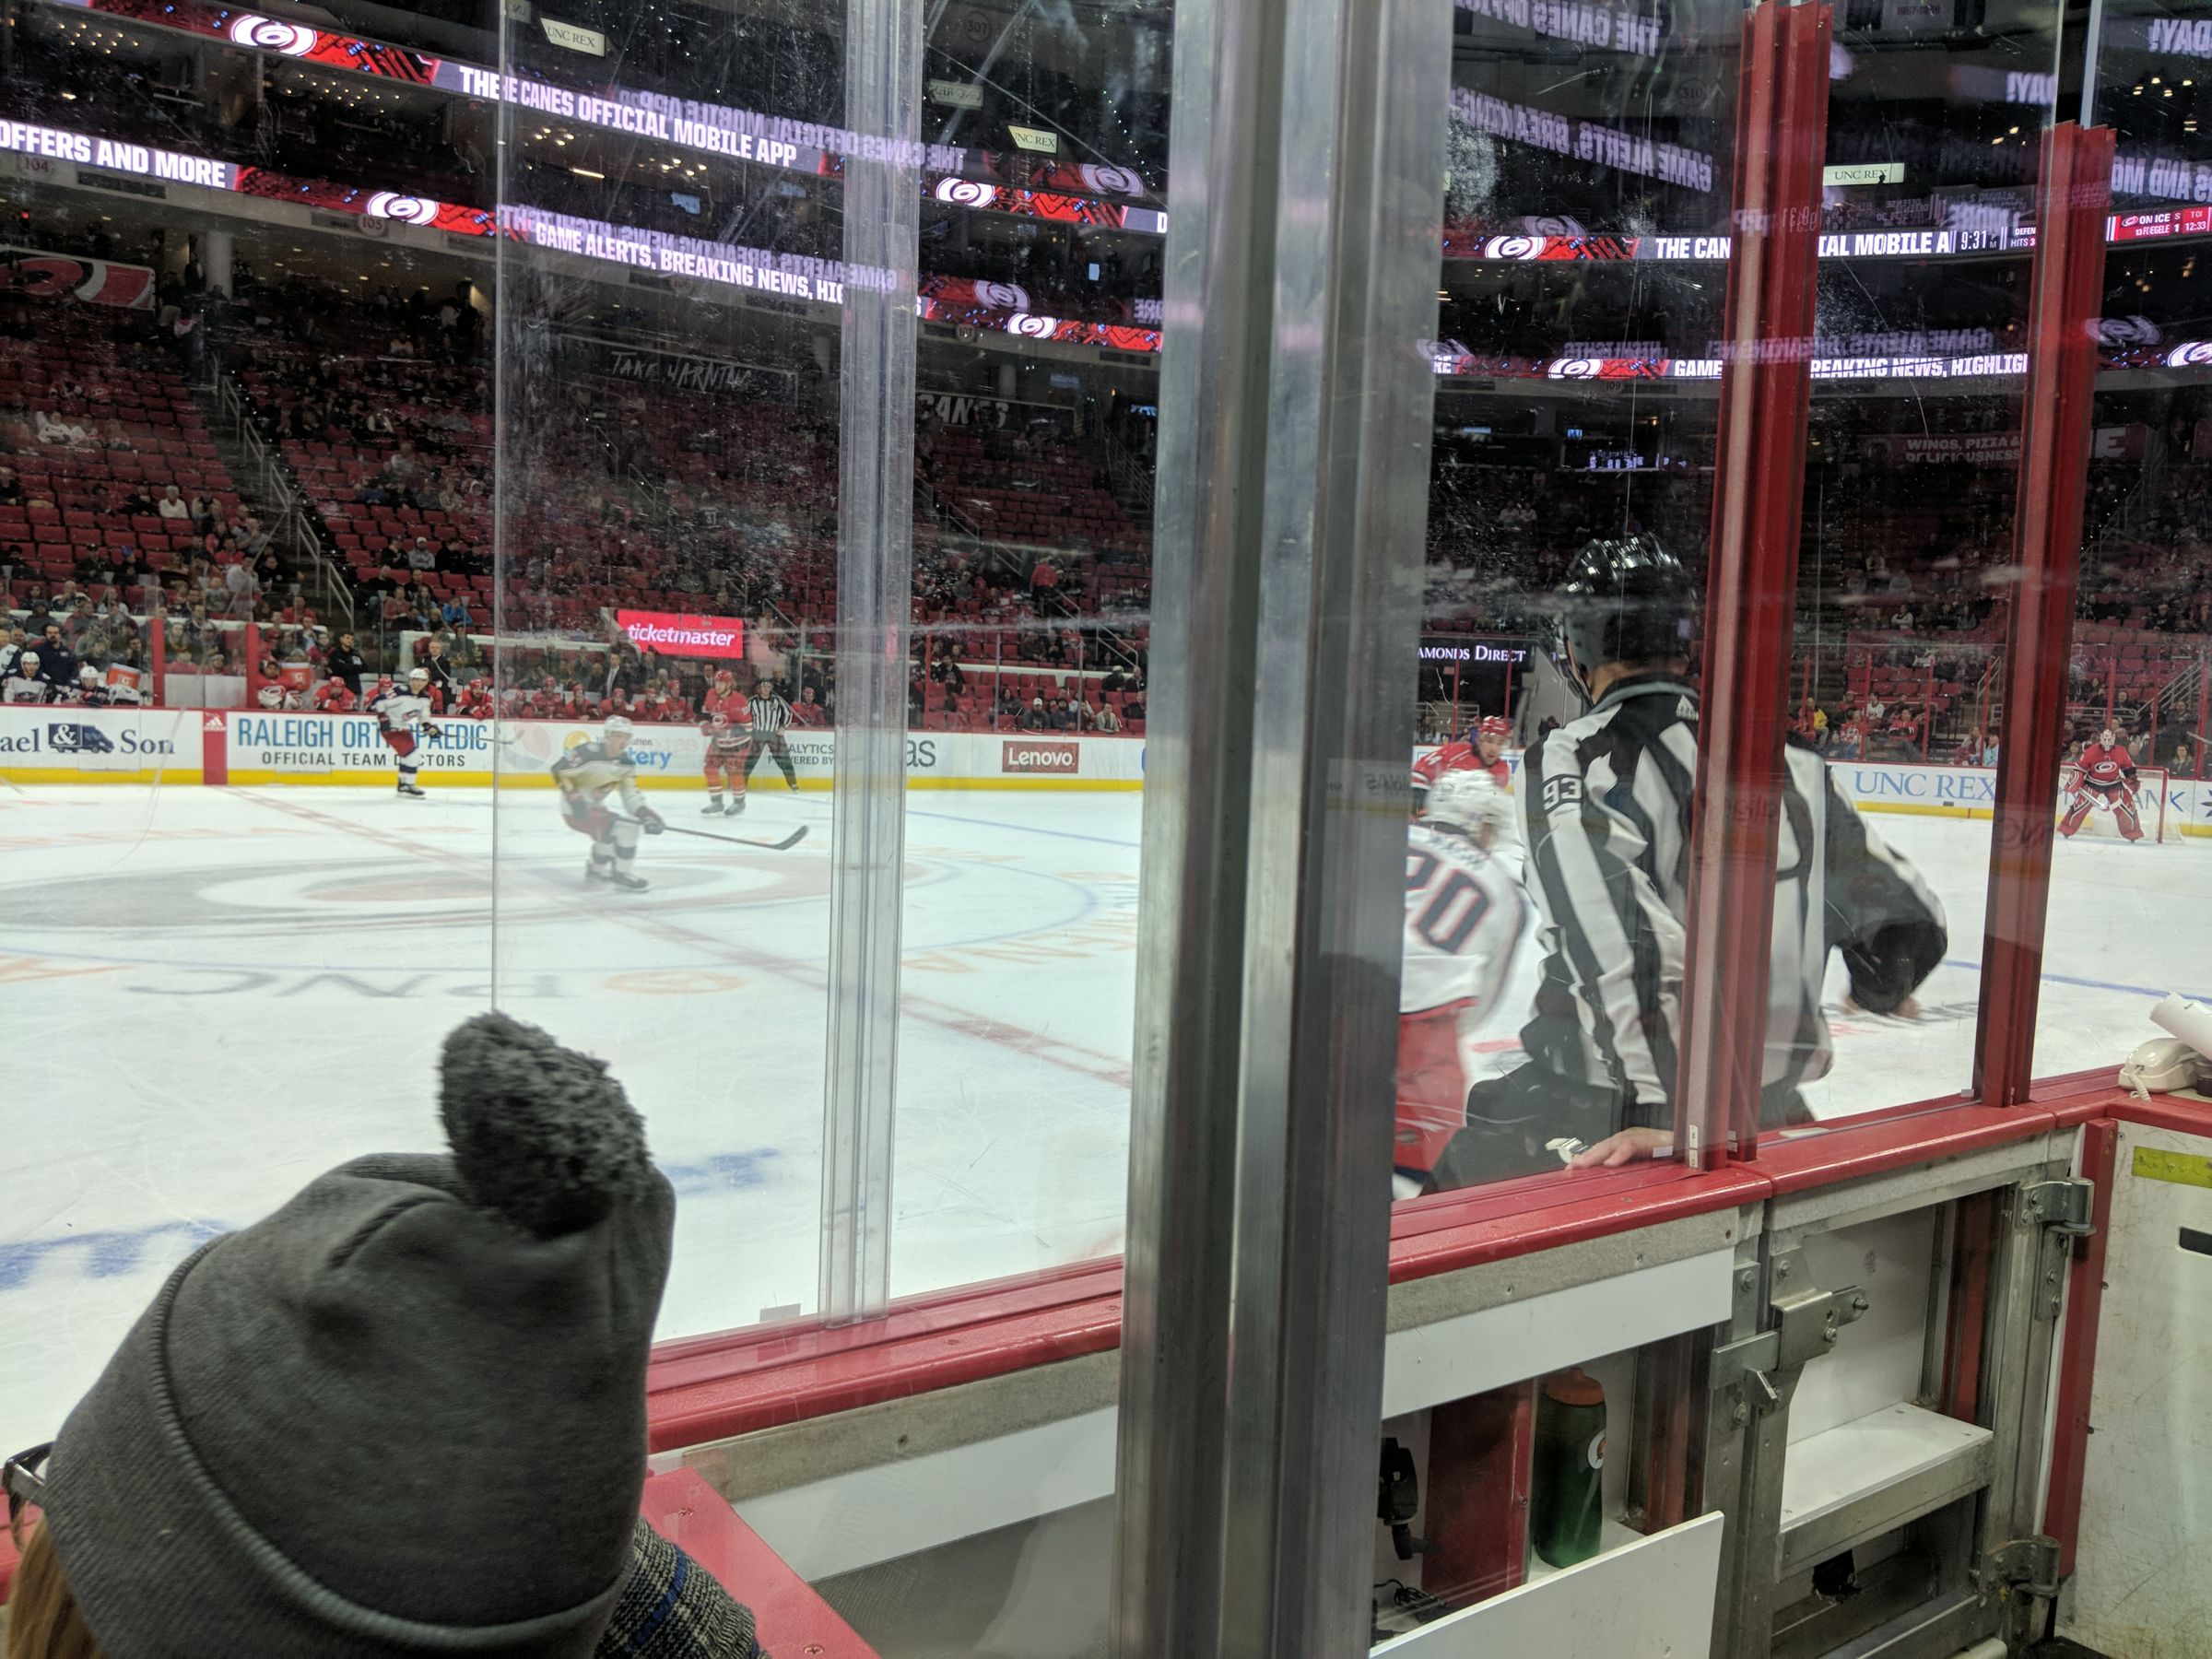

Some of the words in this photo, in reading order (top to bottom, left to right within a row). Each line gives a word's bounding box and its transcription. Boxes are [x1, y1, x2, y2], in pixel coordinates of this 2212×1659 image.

[547, 26, 570, 41] UNC
[572, 33, 595, 48] REX
[521, 81, 573, 117] CANES
[578, 95, 669, 139] OFFICIAL
[674, 118, 752, 159] MOBILE
[756, 138, 796, 167] APP
[1035, 135, 1056, 147] REX
[23, 159, 50, 173] 104
[97, 140, 149, 174] AND
[155, 151, 226, 188] MORE
[1835, 171, 1863, 180] UNC
[361, 218, 383, 230] 105
[2139, 215, 2153, 225] ON
[2155, 213, 2171, 223] ICE
[2185, 220, 2206, 231] 12:33
[1655, 238, 1689, 259] THE
[1854, 232, 1932, 256] MOBILE
[1960, 229, 1987, 250] 9:31
[2010, 238, 2029, 248] HITS
[535, 221, 582, 253] GAME
[585, 232, 657, 270] ALERTS,
[661, 248, 753, 287] BREAKING
[758, 268, 813, 300] NEWS,
[1674, 359, 1723, 377] GAME
[1891, 356, 1947, 378] NEWS,
[1606, 381, 1621, 391] 109
[1965, 436, 2007, 449] PIZZA
[628, 623, 735, 647] ticketmaster
[1475, 645, 1526, 662] DIRECT
[53, 724, 77, 746] &
[121, 728, 175, 754] Son
[238, 718, 333, 747] RALEIGH
[342, 720, 488, 751] ORTPAEDIC
[262, 751, 335, 766] OFFICIAL
[342, 753, 387, 767] TEAM
[394, 754, 465, 767] DCTORS
[821, 757, 834, 765] BY
[1008, 747, 1074, 767] Lenovo
[1543, 778, 1583, 811] 93
[1854, 771, 1926, 797] UNC
[1934, 774, 1997, 802] REX
